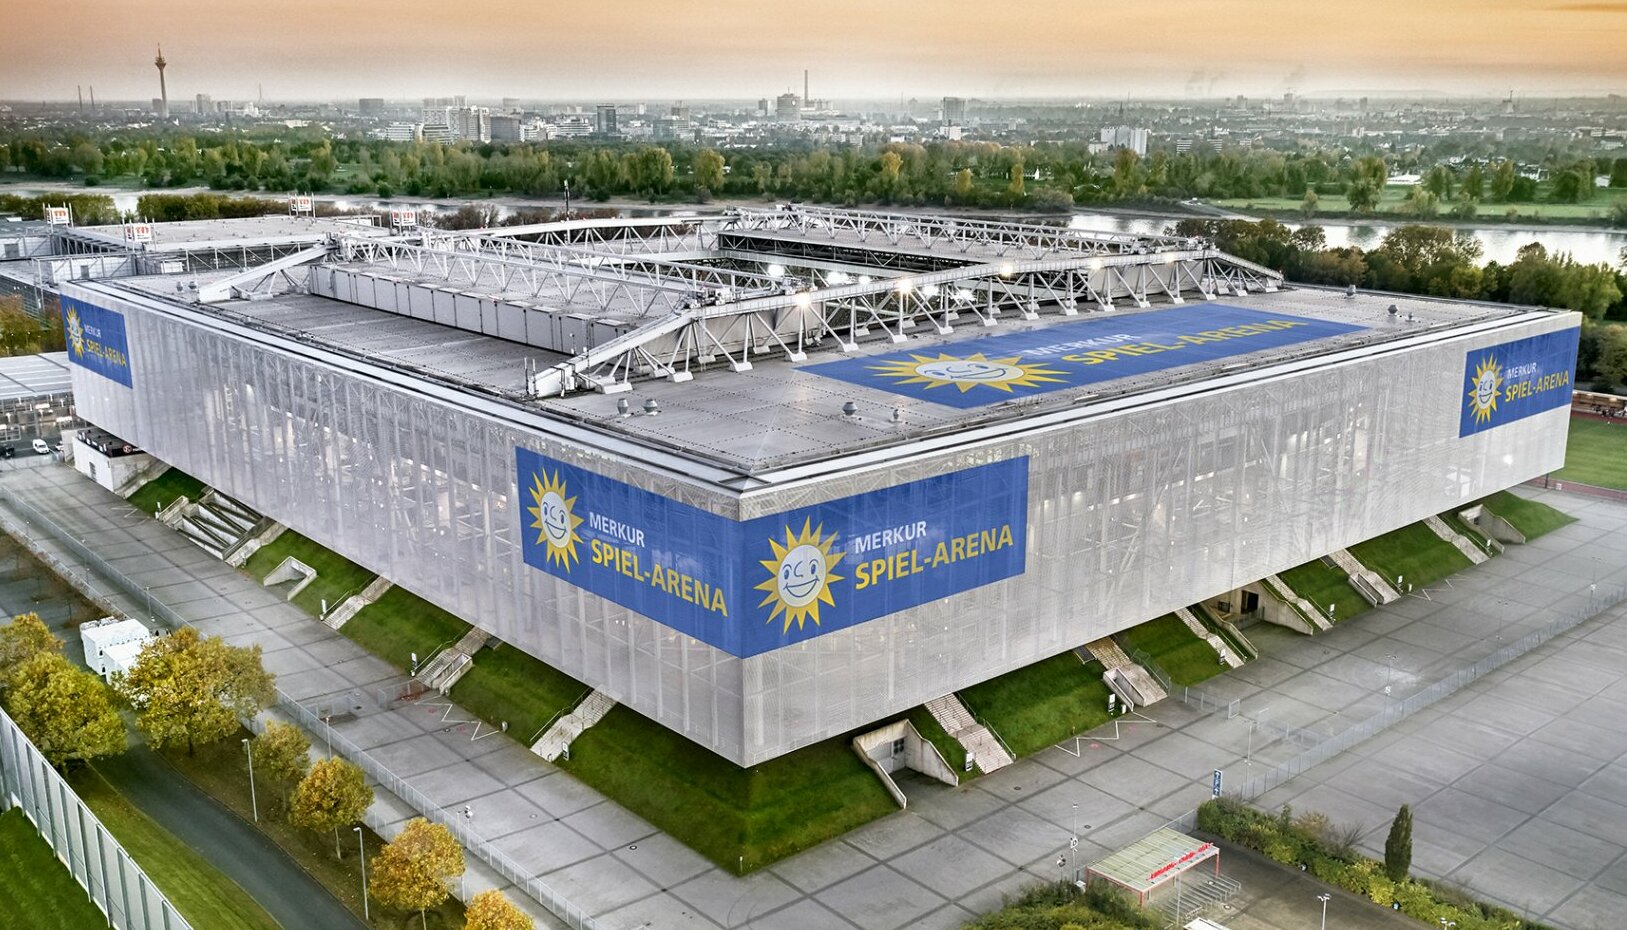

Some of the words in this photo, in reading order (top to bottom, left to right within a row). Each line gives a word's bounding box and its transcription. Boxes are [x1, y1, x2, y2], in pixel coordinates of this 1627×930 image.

[1022, 333, 1141, 356] MERKUR
[1060, 319, 1309, 365] SPIEL-ARENA
[1505, 370, 1569, 402] SPIEL-ARENA
[1507, 362, 1537, 380] MERKUR
[589, 511, 645, 548] MERKUR
[855, 521, 927, 553] MERKUR
[855, 524, 1014, 590] SPIEL-ARENA
[590, 538, 728, 617] SPIEL-ARENA
